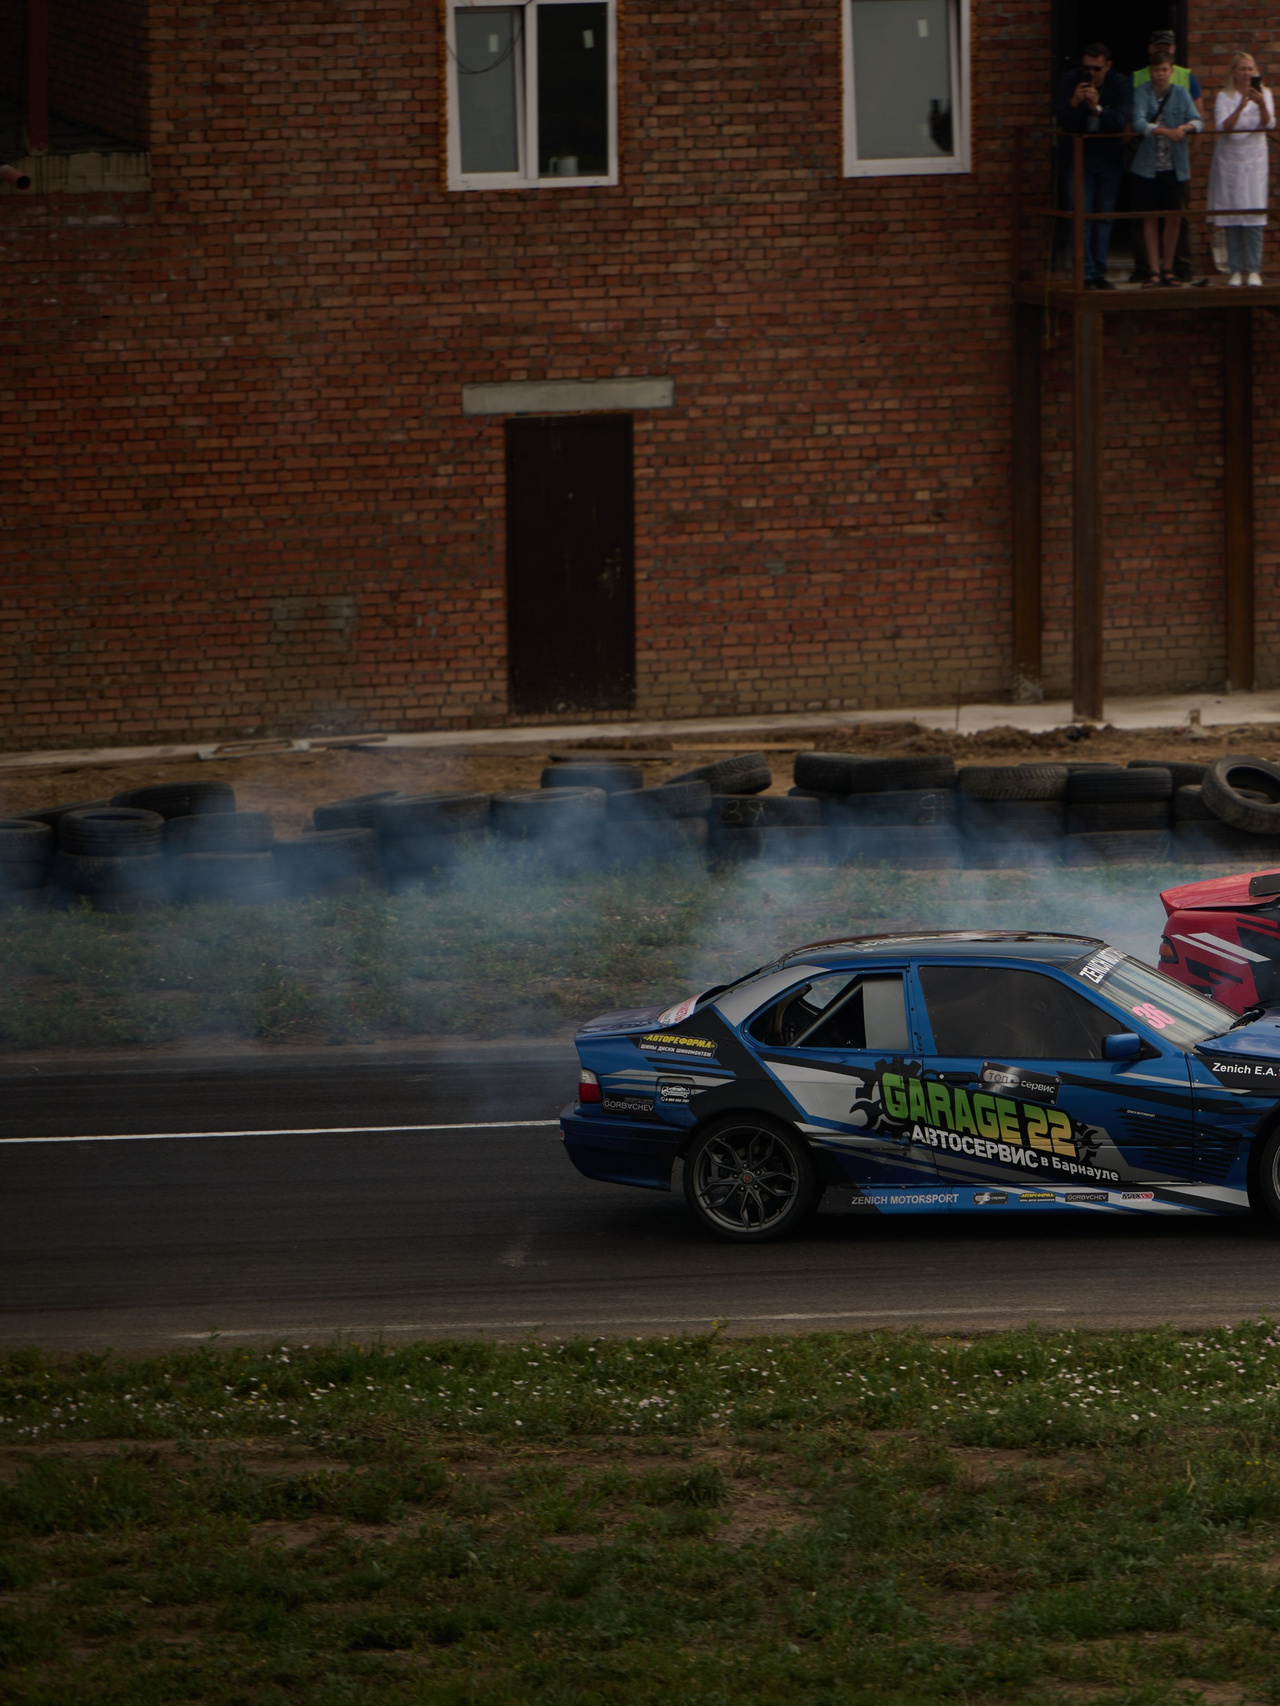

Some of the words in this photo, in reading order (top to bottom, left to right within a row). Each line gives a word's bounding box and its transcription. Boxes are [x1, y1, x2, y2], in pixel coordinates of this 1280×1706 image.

[1132, 1003, 1175, 1030] 30
[1212, 1062, 1251, 1075] Zenich
[1254, 1066, 1278, 1077] E.A.
[988, 1072, 1009, 1084] ТОП
[1021, 1080, 1056, 1094] сервис
[882, 1072, 1022, 1147] GARAGE
[1022, 1103, 1077, 1158] 22
[911, 1125, 1039, 1169] АВТОСЕРВИС
[1040, 1156, 1049, 1167] в
[1052, 1156, 1119, 1181] Барнауле
[851, 1196, 888, 1205] ZENICH
[890, 1193, 959, 1204] MOTORSPORT
